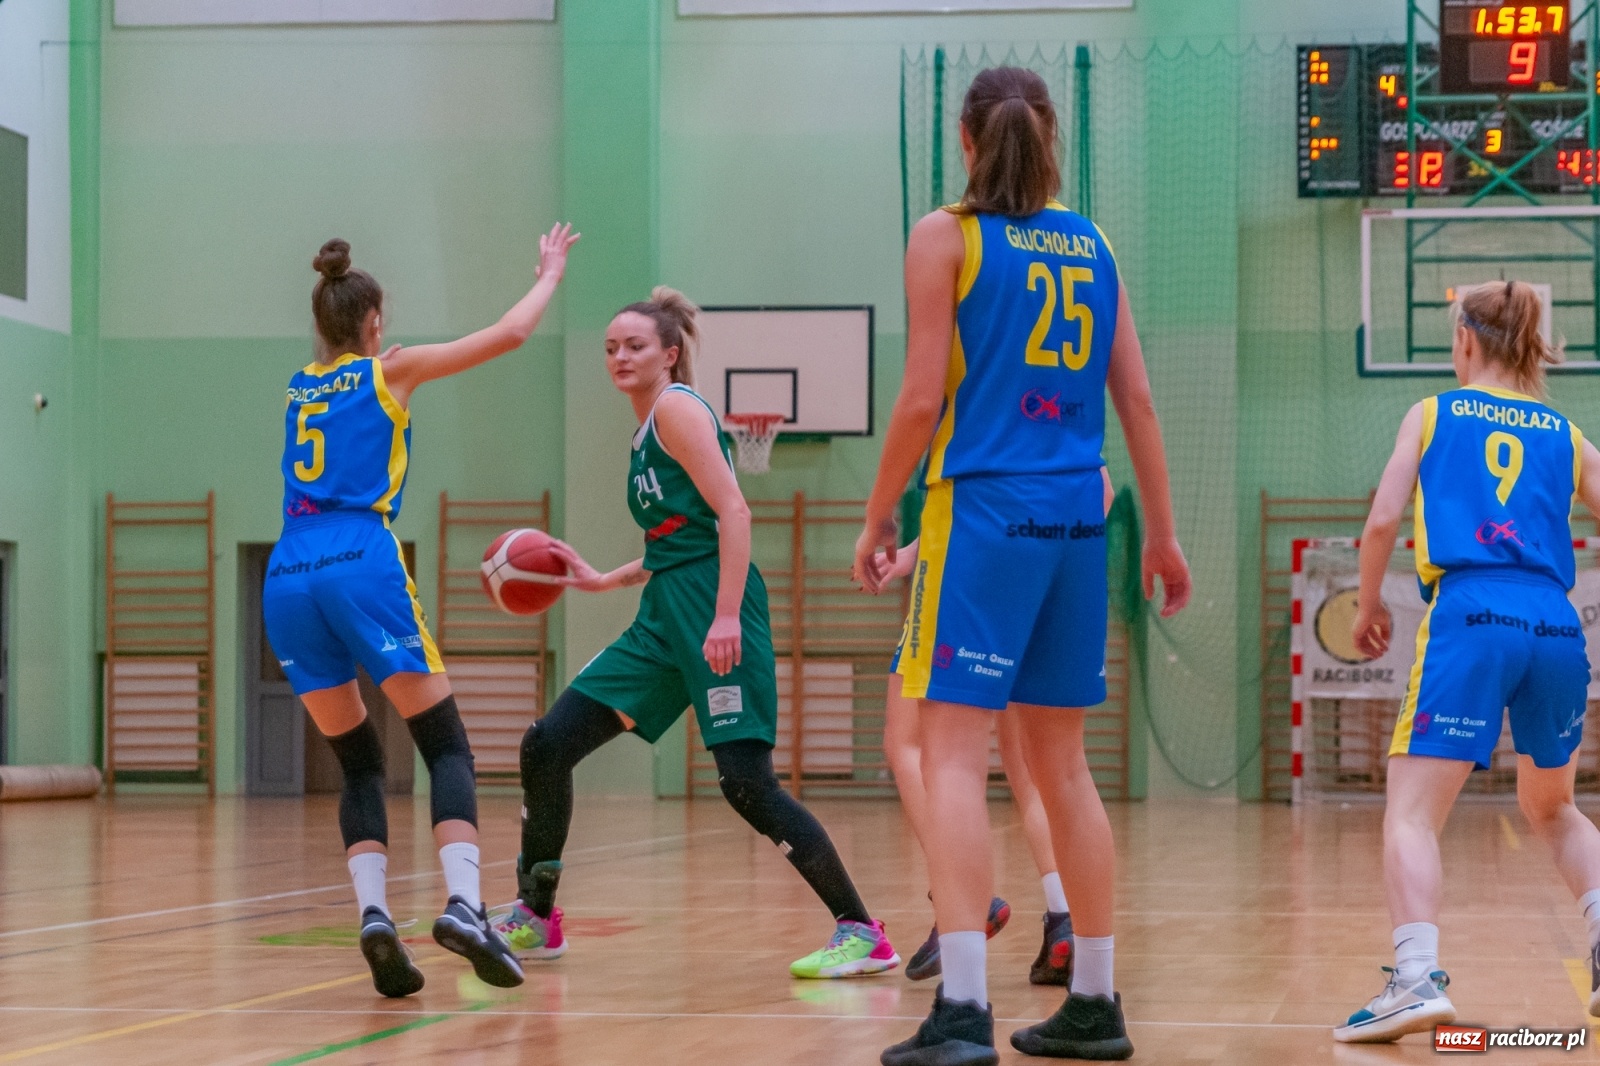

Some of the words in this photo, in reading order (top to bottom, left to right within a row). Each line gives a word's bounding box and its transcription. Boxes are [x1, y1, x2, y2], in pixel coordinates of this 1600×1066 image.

[1507, 41, 1537, 83] 9
[1379, 75, 1396, 96] 4
[1485, 129, 1502, 152] 3
[1006, 225, 1098, 259] GŁUCHOŁAZY
[1025, 262, 1094, 370] 25
[1451, 399, 1561, 431] GŁUCHOŁAZY
[294, 402, 329, 481] 5
[1485, 431, 1524, 507] 9
[634, 467, 664, 509] 24
[1006, 518, 1066, 539] schatt
[269, 562, 312, 578] chatt
[314, 549, 365, 571] decor
[1465, 608, 1529, 632] schatt
[1313, 667, 1394, 683] RACIBORZ
